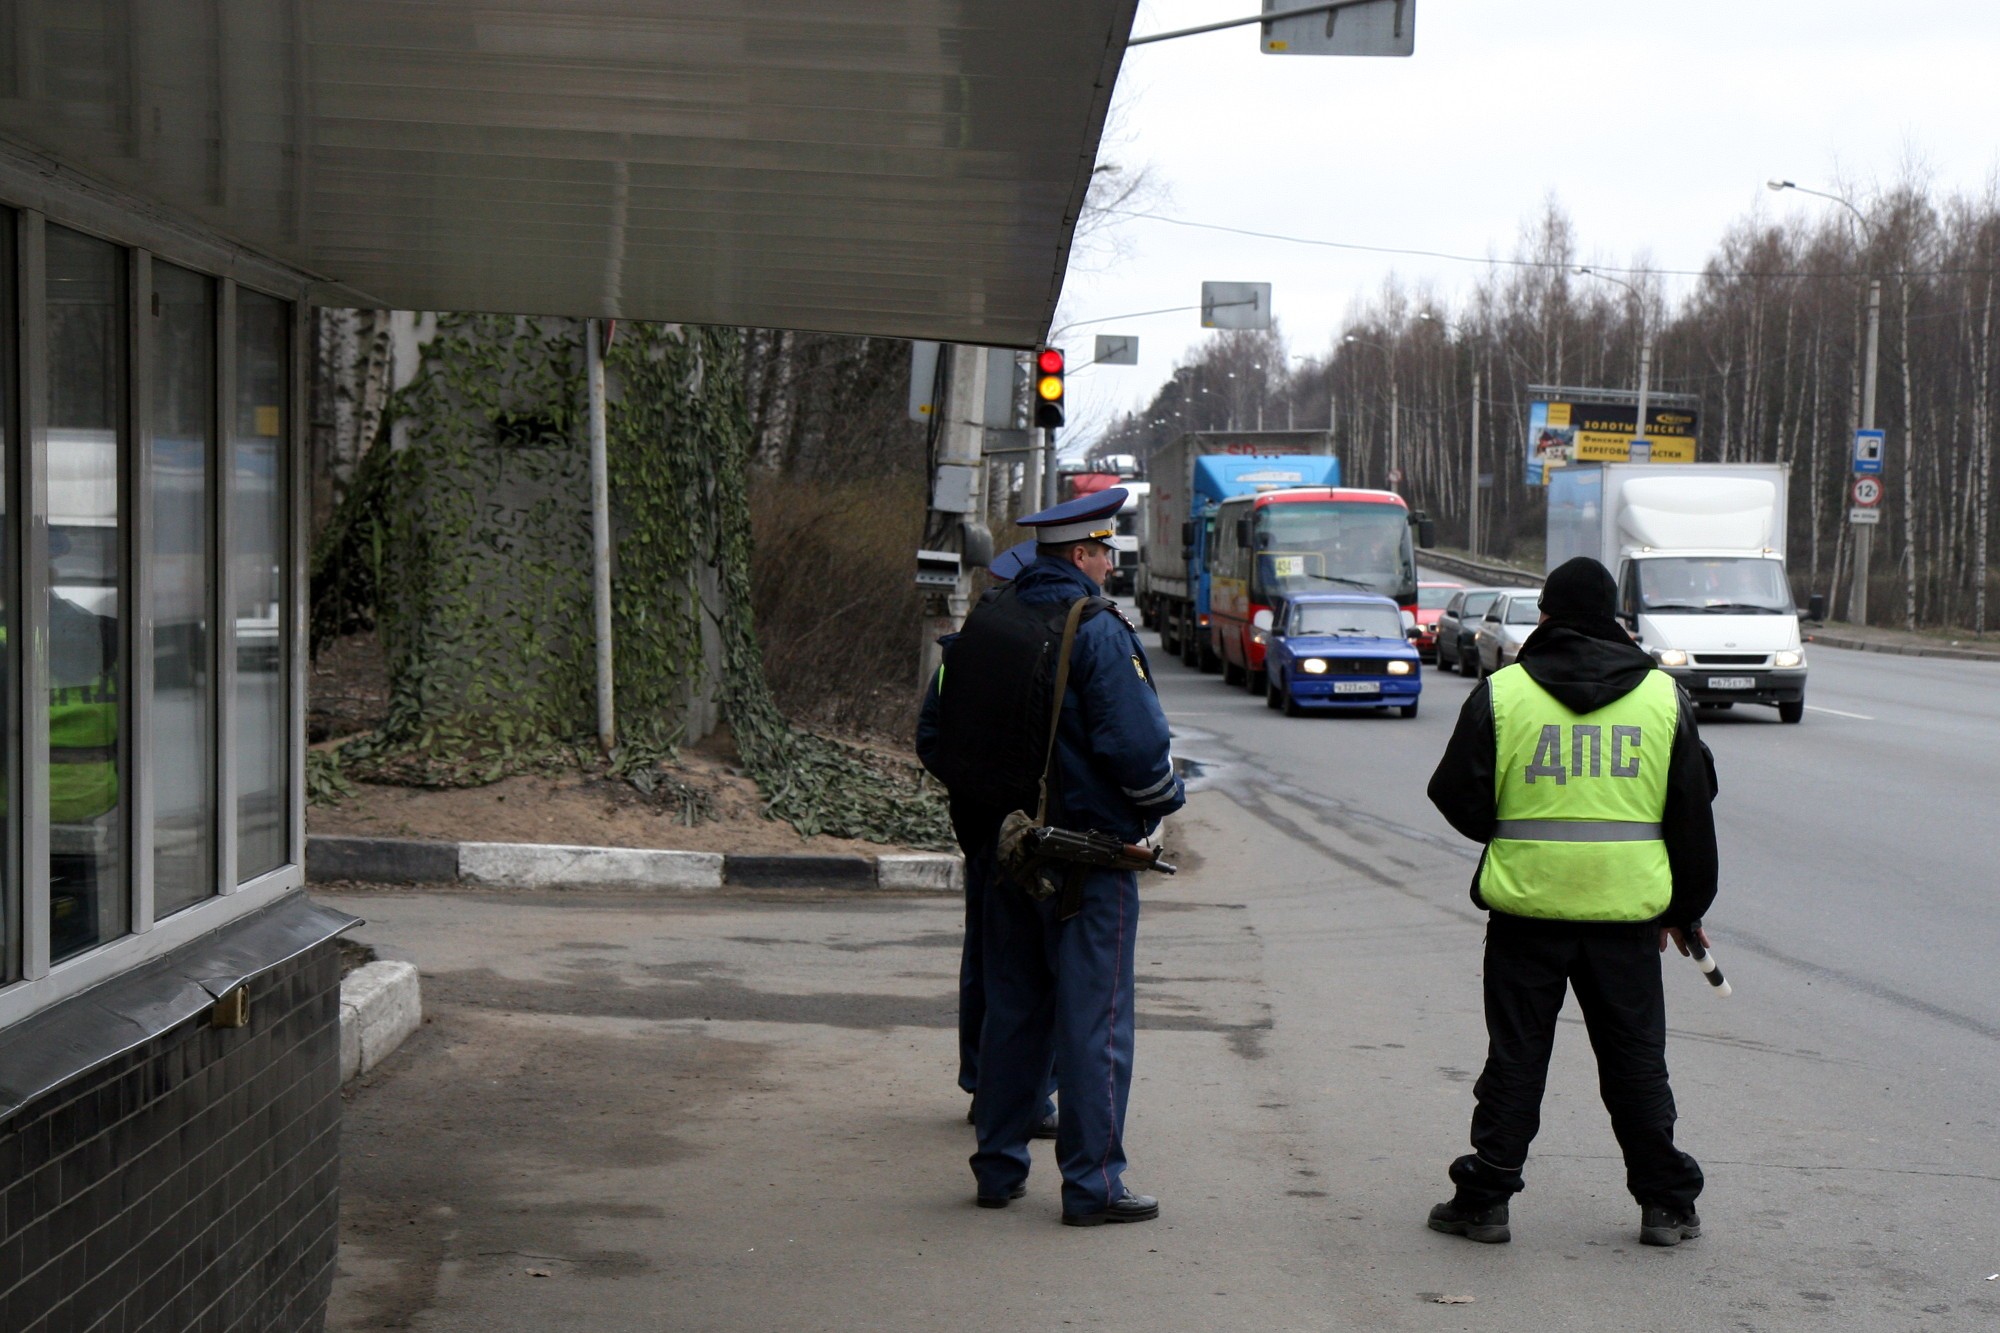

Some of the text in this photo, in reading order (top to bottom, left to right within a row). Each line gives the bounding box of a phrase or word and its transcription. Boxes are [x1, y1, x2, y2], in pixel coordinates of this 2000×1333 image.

[1584, 420, 1685, 434] ЗОЛОТЫ ПЕСКИ
[1583, 435, 1624, 444] Финский
[1650, 449, 1682, 458] АСТКИ
[1525, 724, 1641, 785] ДПС
